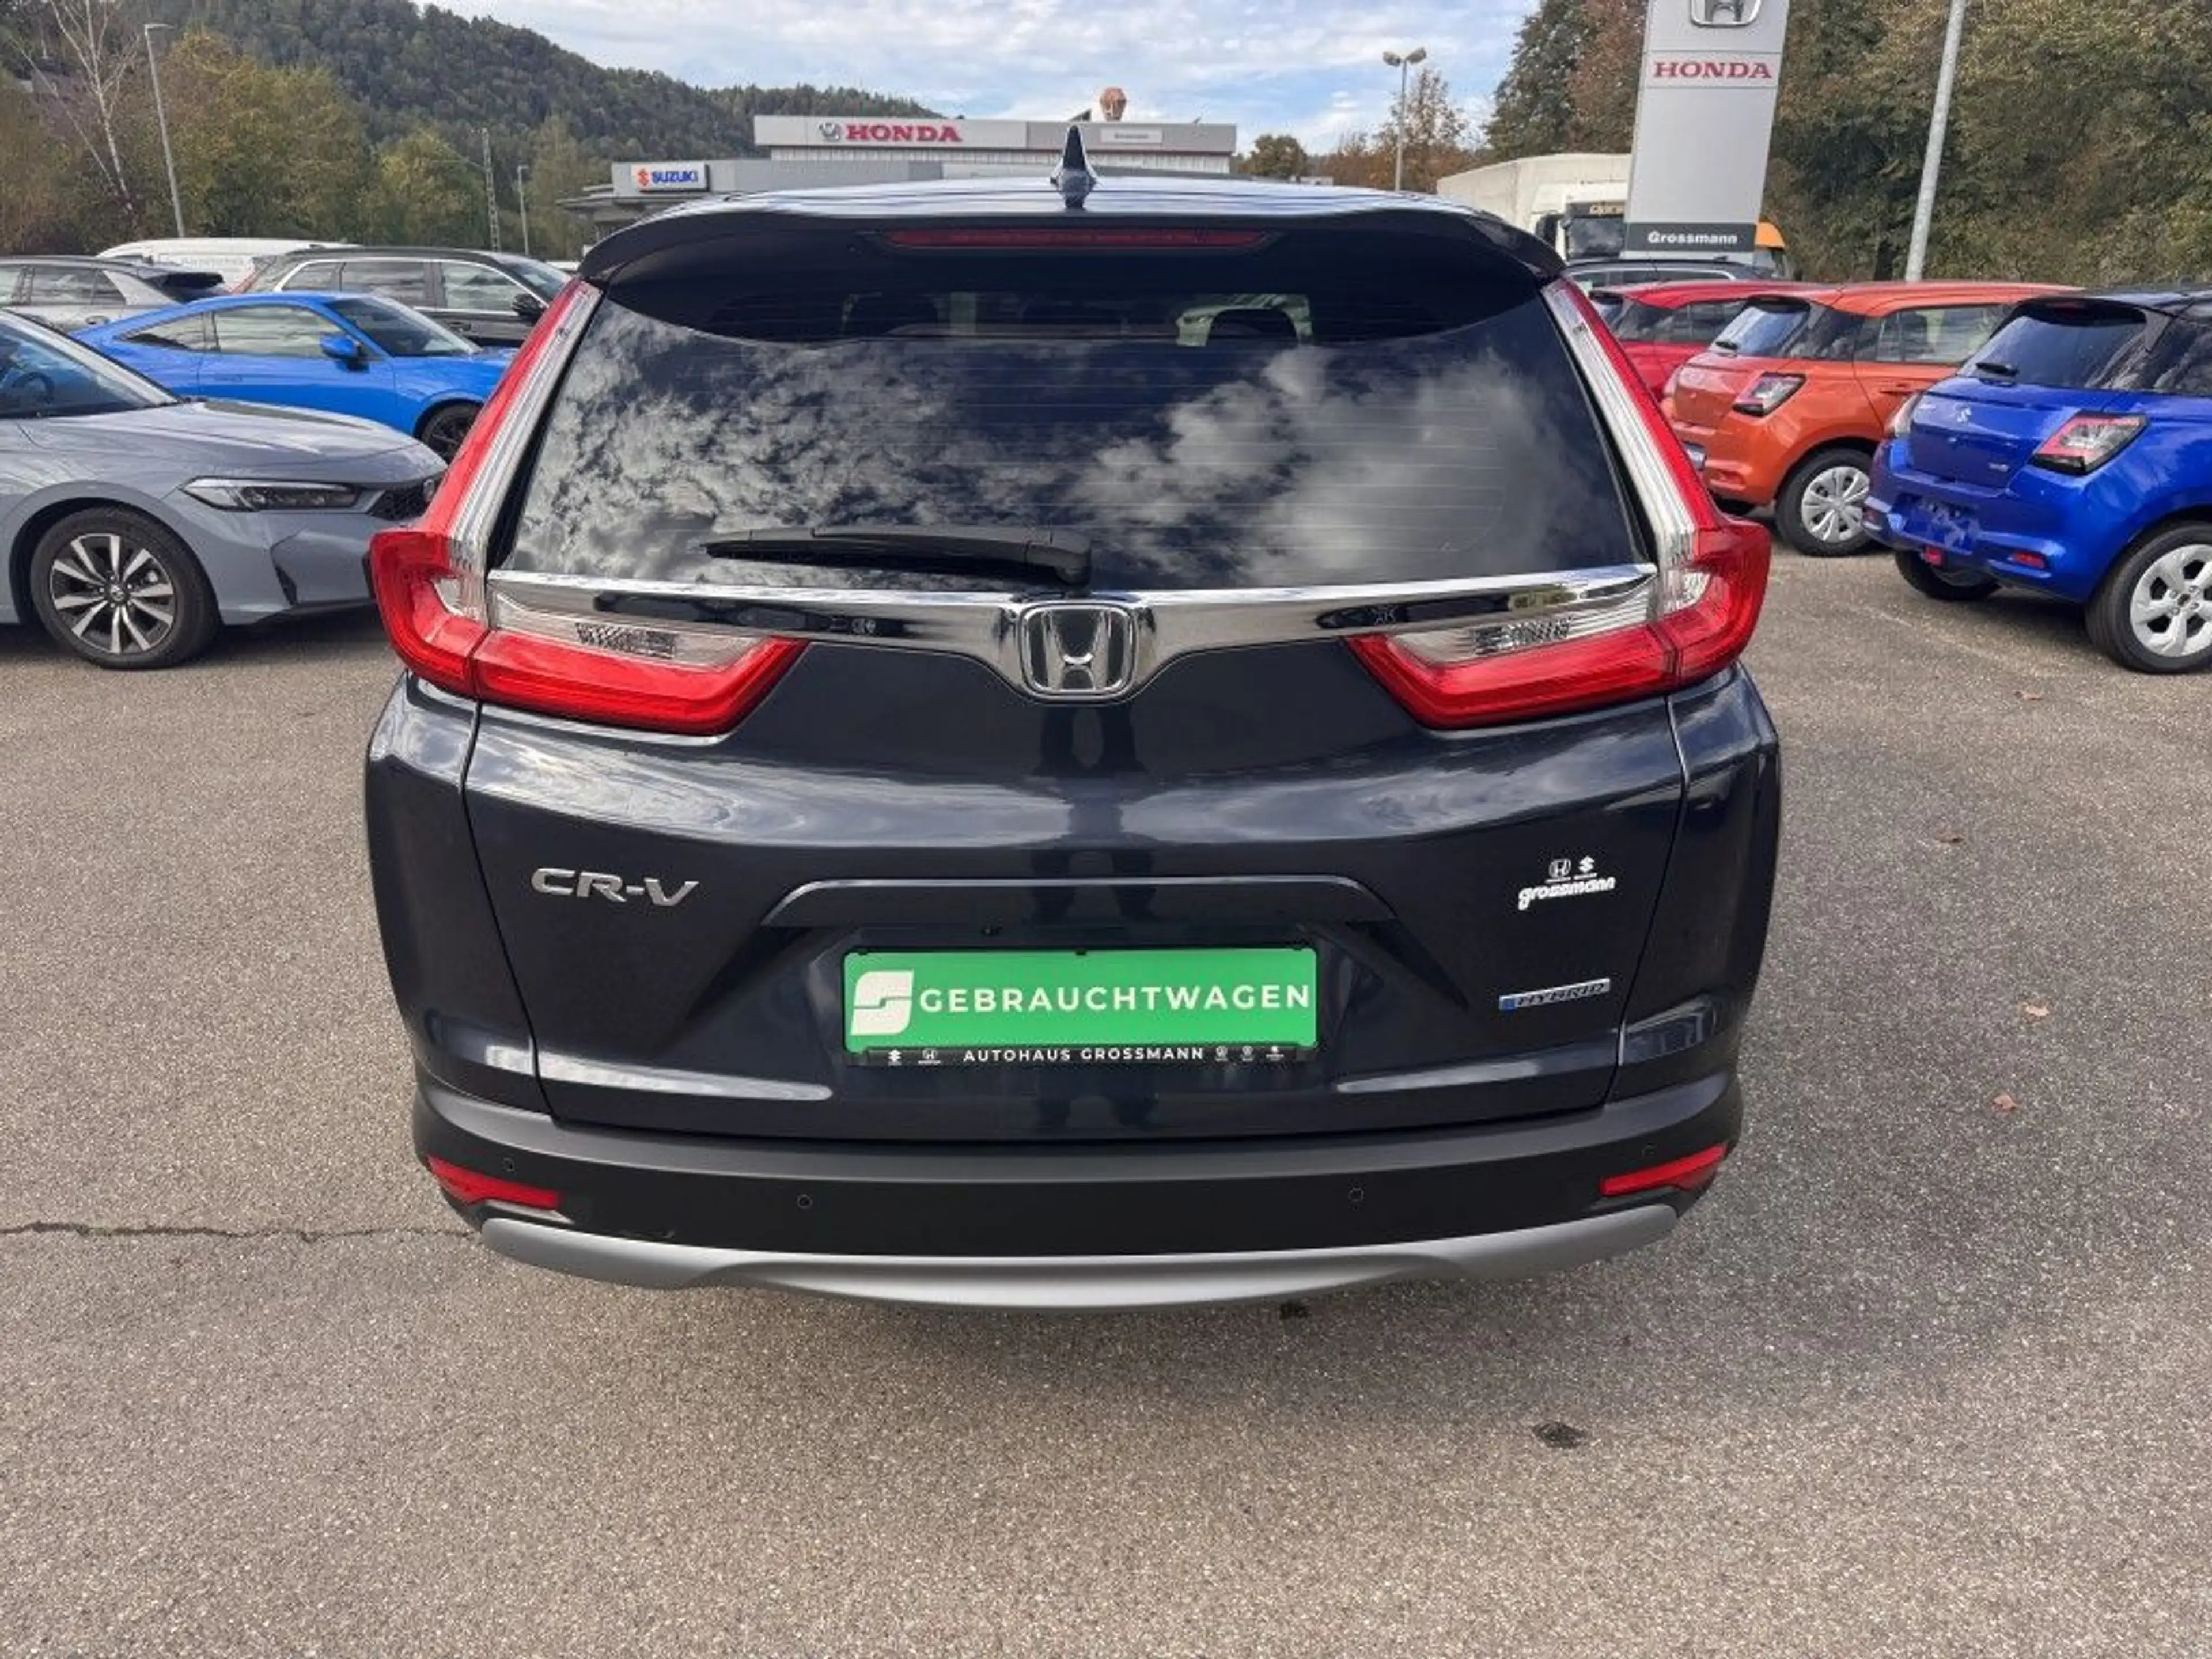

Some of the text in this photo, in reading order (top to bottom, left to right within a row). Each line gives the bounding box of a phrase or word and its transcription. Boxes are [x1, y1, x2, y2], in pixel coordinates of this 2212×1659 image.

[1654, 62, 1772, 78] HONDA
[846, 124, 963, 142] HONDA
[652, 169, 699, 183] SUZUKI
[1647, 231, 1738, 244] Grossmann
[531, 868, 699, 906] CR-V
[1518, 876, 1616, 910] grossmann
[919, 984, 1309, 1012] GEBRAUCHTWAGEN
[963, 1047, 1204, 1063] AUTOHAUS GROSSMANN
